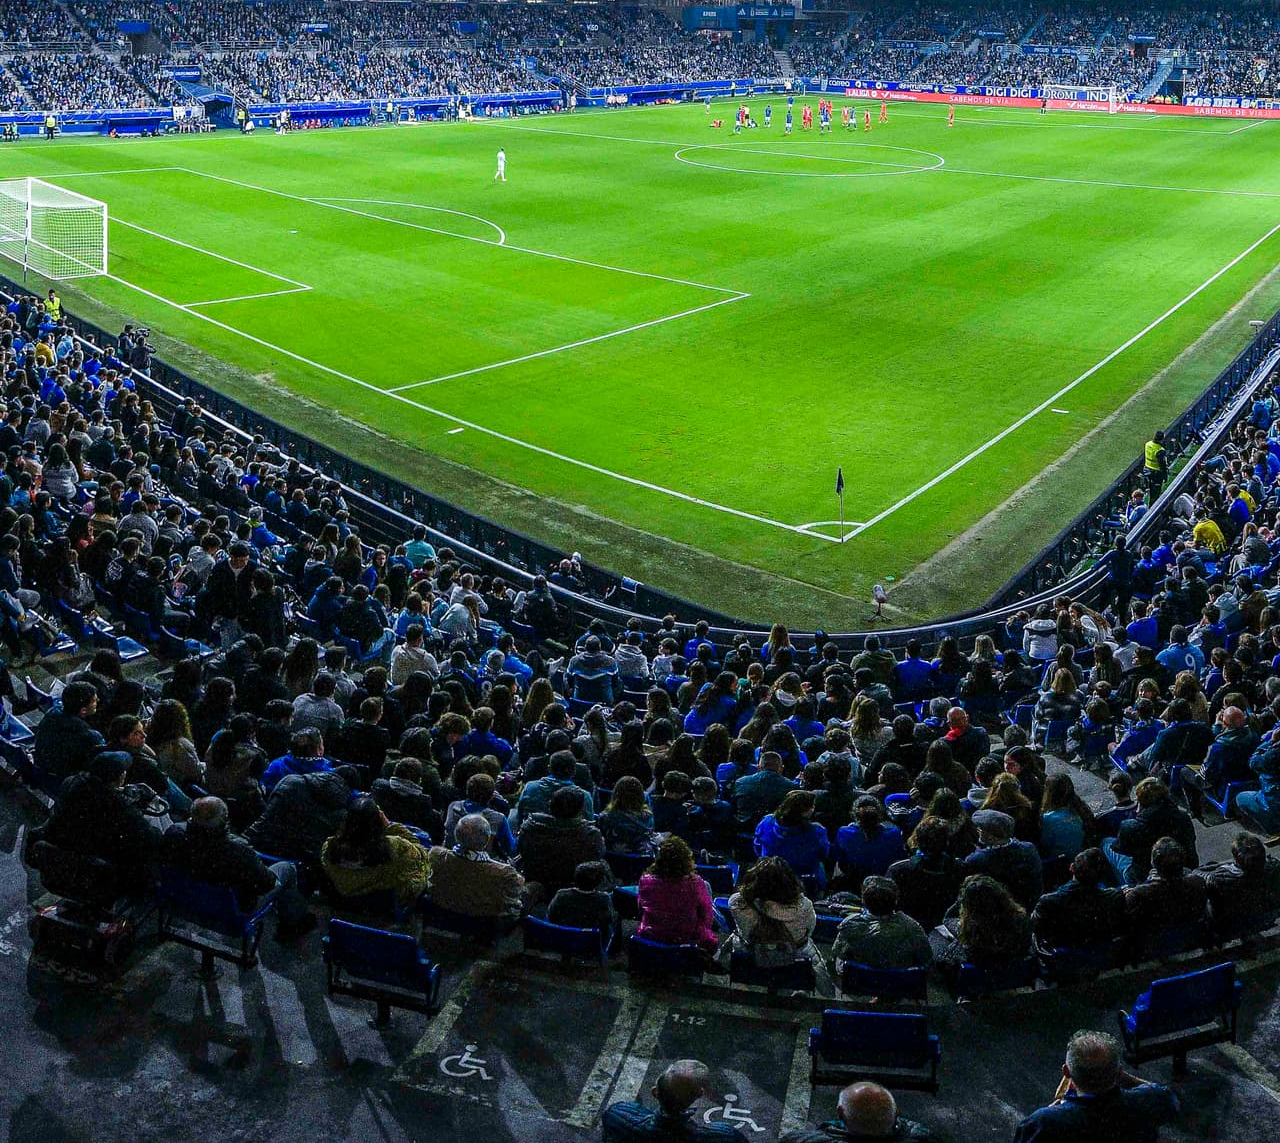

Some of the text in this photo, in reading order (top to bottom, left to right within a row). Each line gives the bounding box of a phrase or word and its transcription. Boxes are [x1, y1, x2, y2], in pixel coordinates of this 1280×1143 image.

[848, 89, 870, 99] LALIGA
[985, 87, 1032, 98] DIGI DIGI
[949, 95, 982, 104] SABEMOS
[1194, 107, 1233, 115] SABEMOS
[672, 1012, 707, 1028] 1.12
